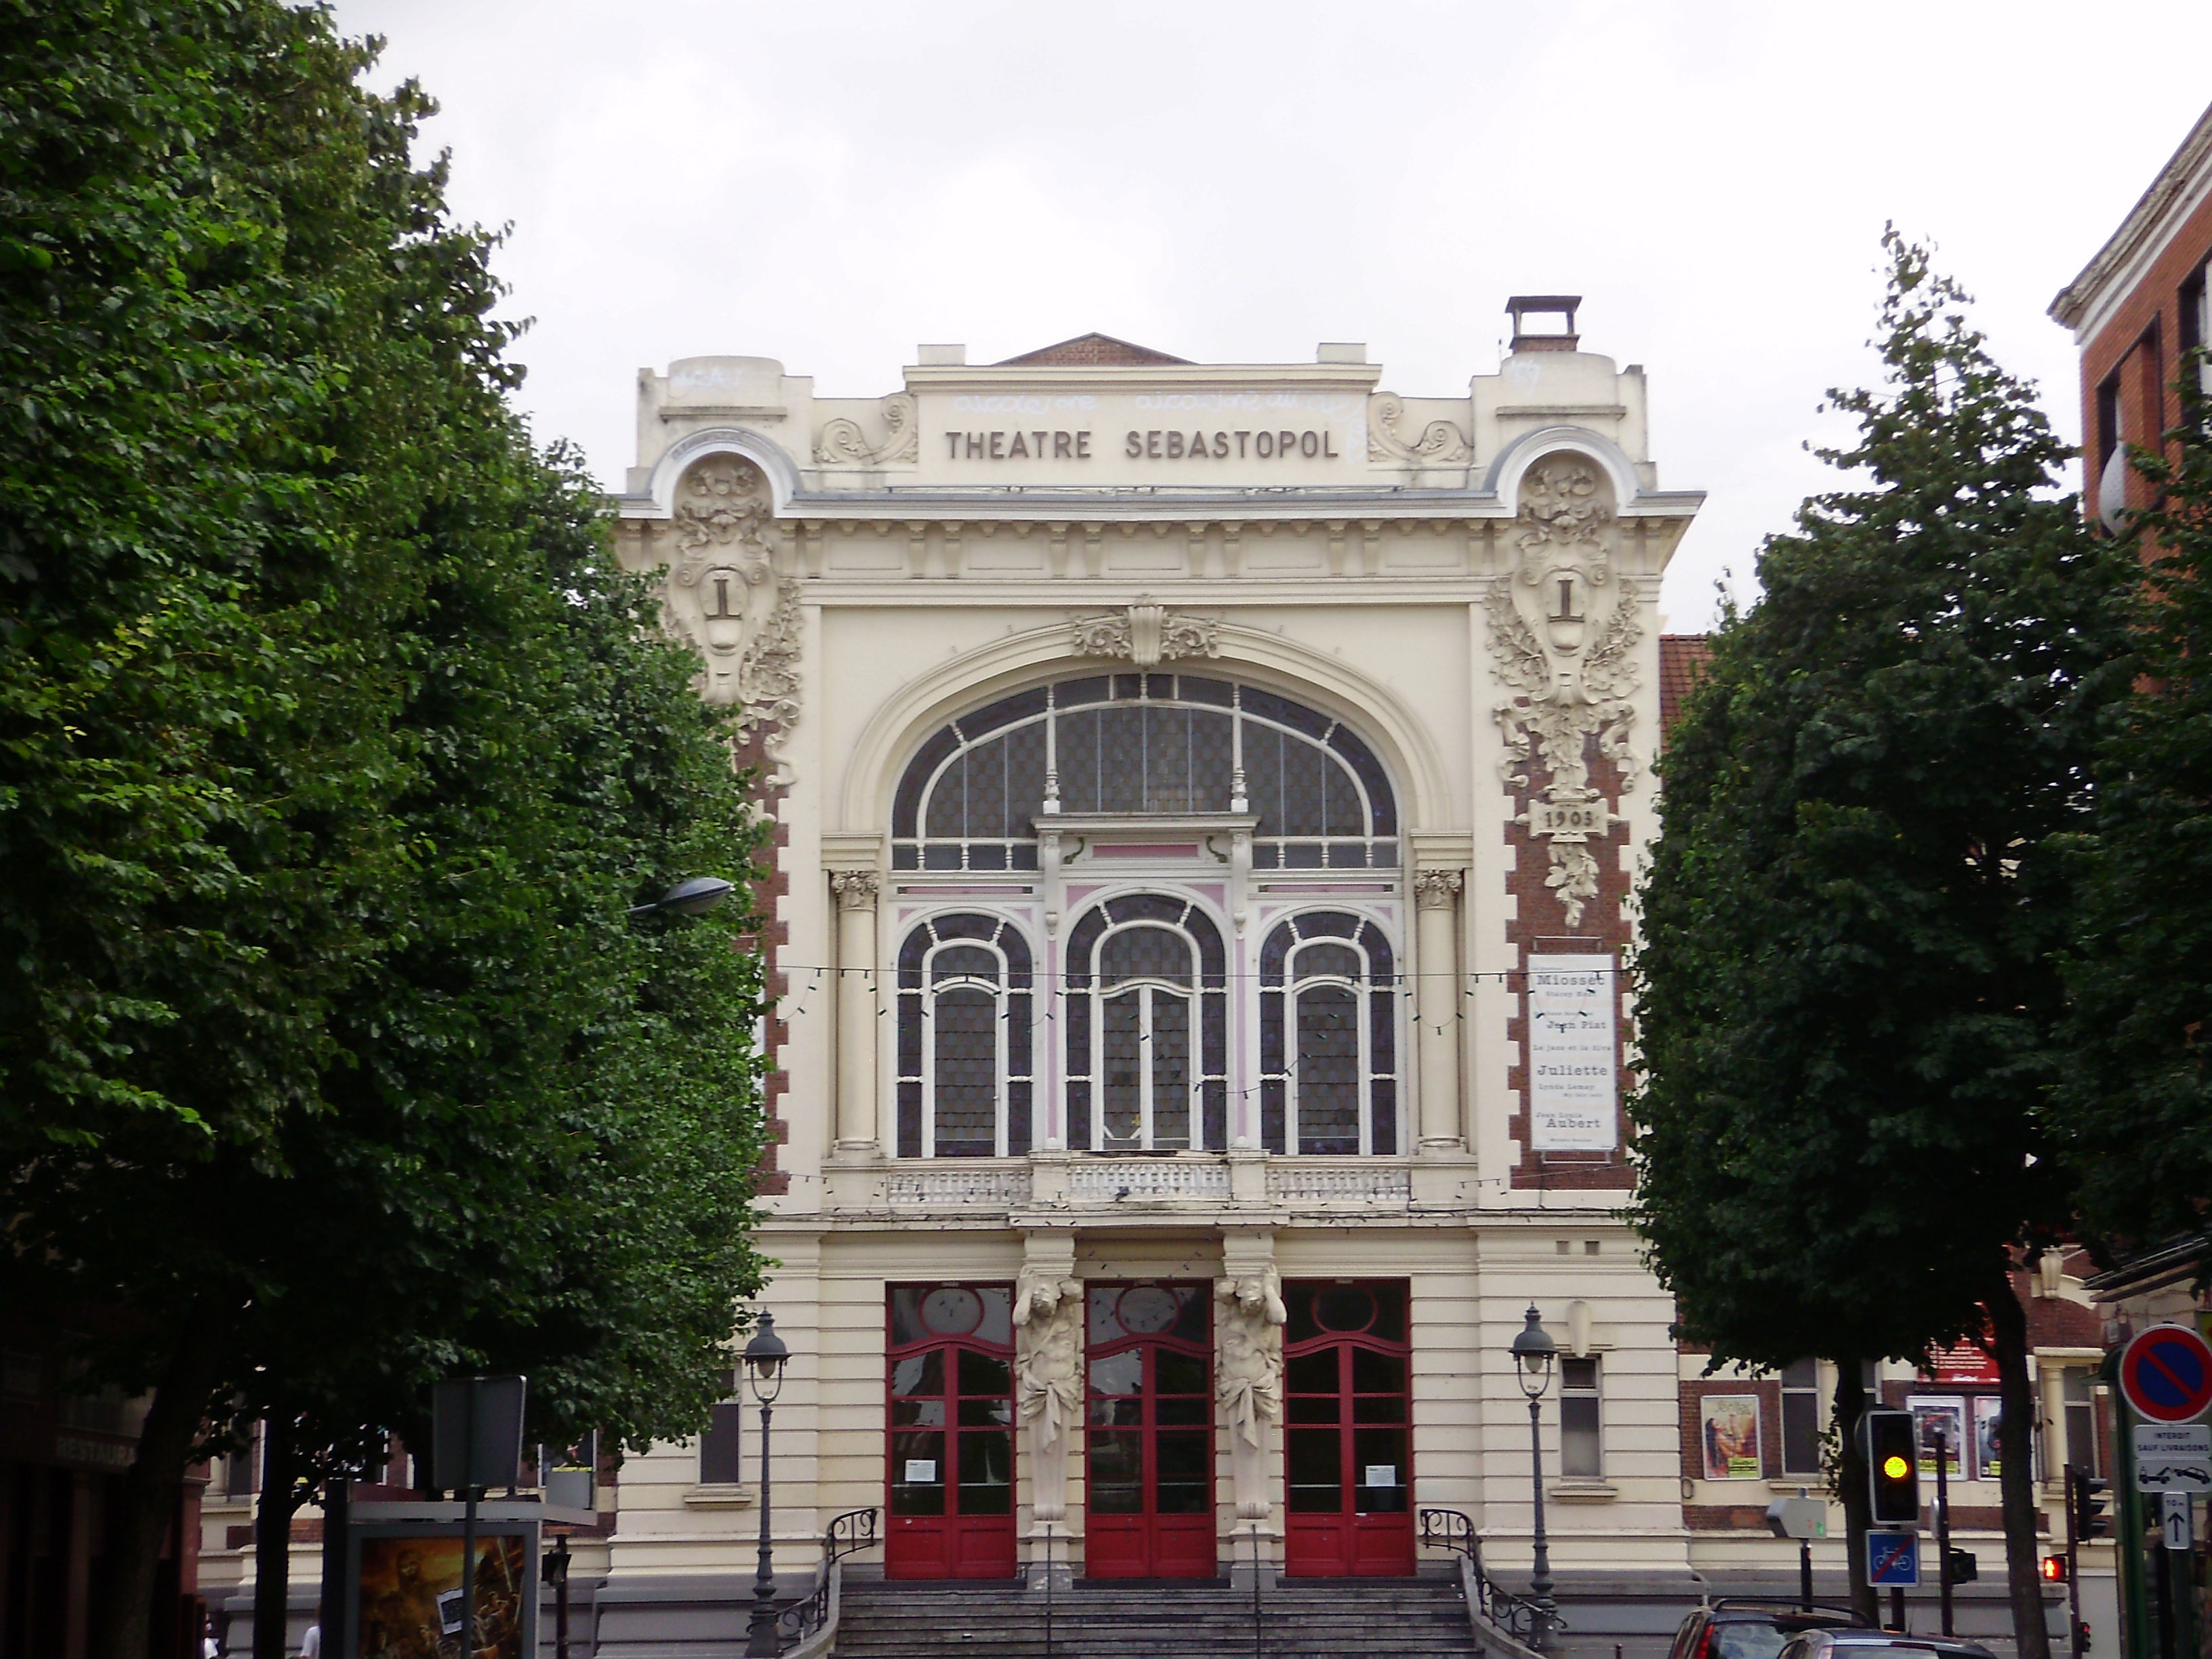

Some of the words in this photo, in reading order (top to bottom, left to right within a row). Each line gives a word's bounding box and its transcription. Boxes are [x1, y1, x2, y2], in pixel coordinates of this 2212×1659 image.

[946, 430, 1092, 459] THEATRE
[1126, 430, 1339, 459] SEBASTOPOL
[1537, 975, 1605, 985] Miossec
[1581, 1021, 1607, 1029] Piat
[1537, 1065, 1607, 1076] Juliette
[1546, 1118, 1601, 1128] Aubert
